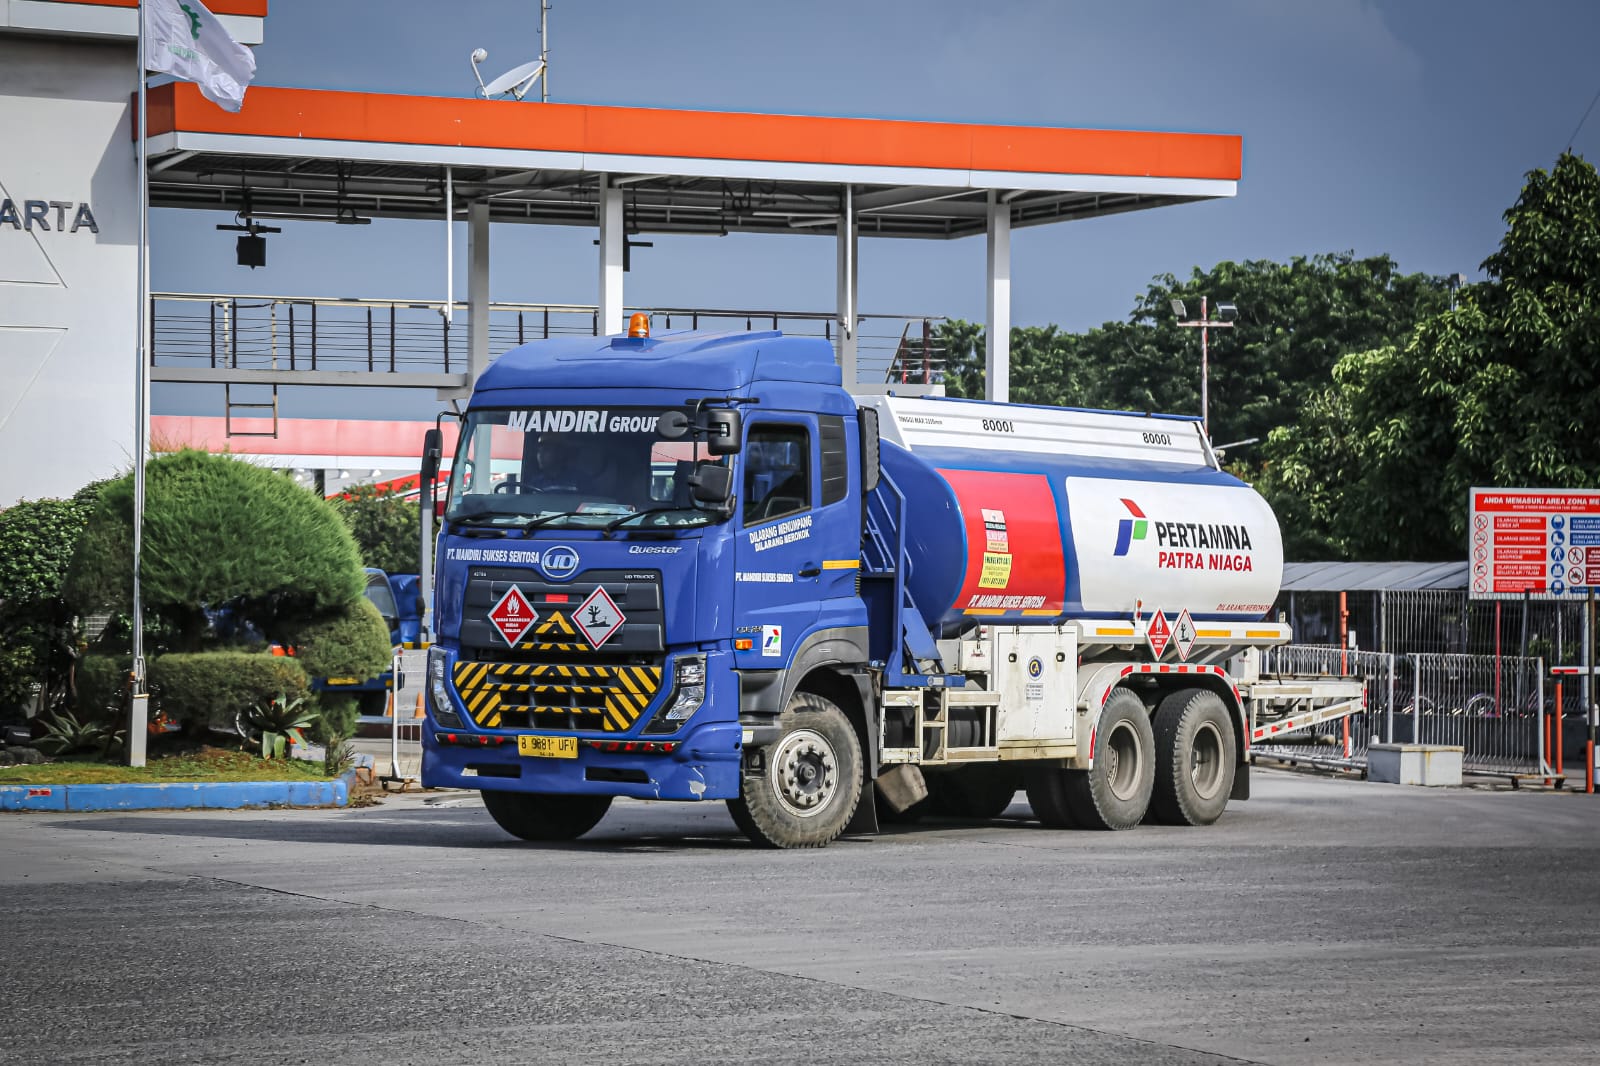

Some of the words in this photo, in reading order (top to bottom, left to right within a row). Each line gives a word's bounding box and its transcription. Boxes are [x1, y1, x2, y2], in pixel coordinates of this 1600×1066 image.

[507, 410, 608, 433] MANDIRI
[1483, 497, 1503, 505] ANDA
[1505, 497, 1544, 505] MEMASUKI
[1546, 497, 1565, 505] AREA
[749, 525, 777, 544] DILARANG
[1155, 521, 1252, 550] PERTAMINA
[628, 545, 682, 554] Quester
[755, 536, 783, 552] DILARANG
[456, 549, 481, 561] MANDIRI
[482, 550, 508, 561] SUKSES
[509, 551, 540, 563] SENTOSA
[1158, 551, 1204, 570] PATRA
[1208, 554, 1253, 572] NIAGA
[521, 737, 527, 749] B
[558, 739, 575, 751] UFV
